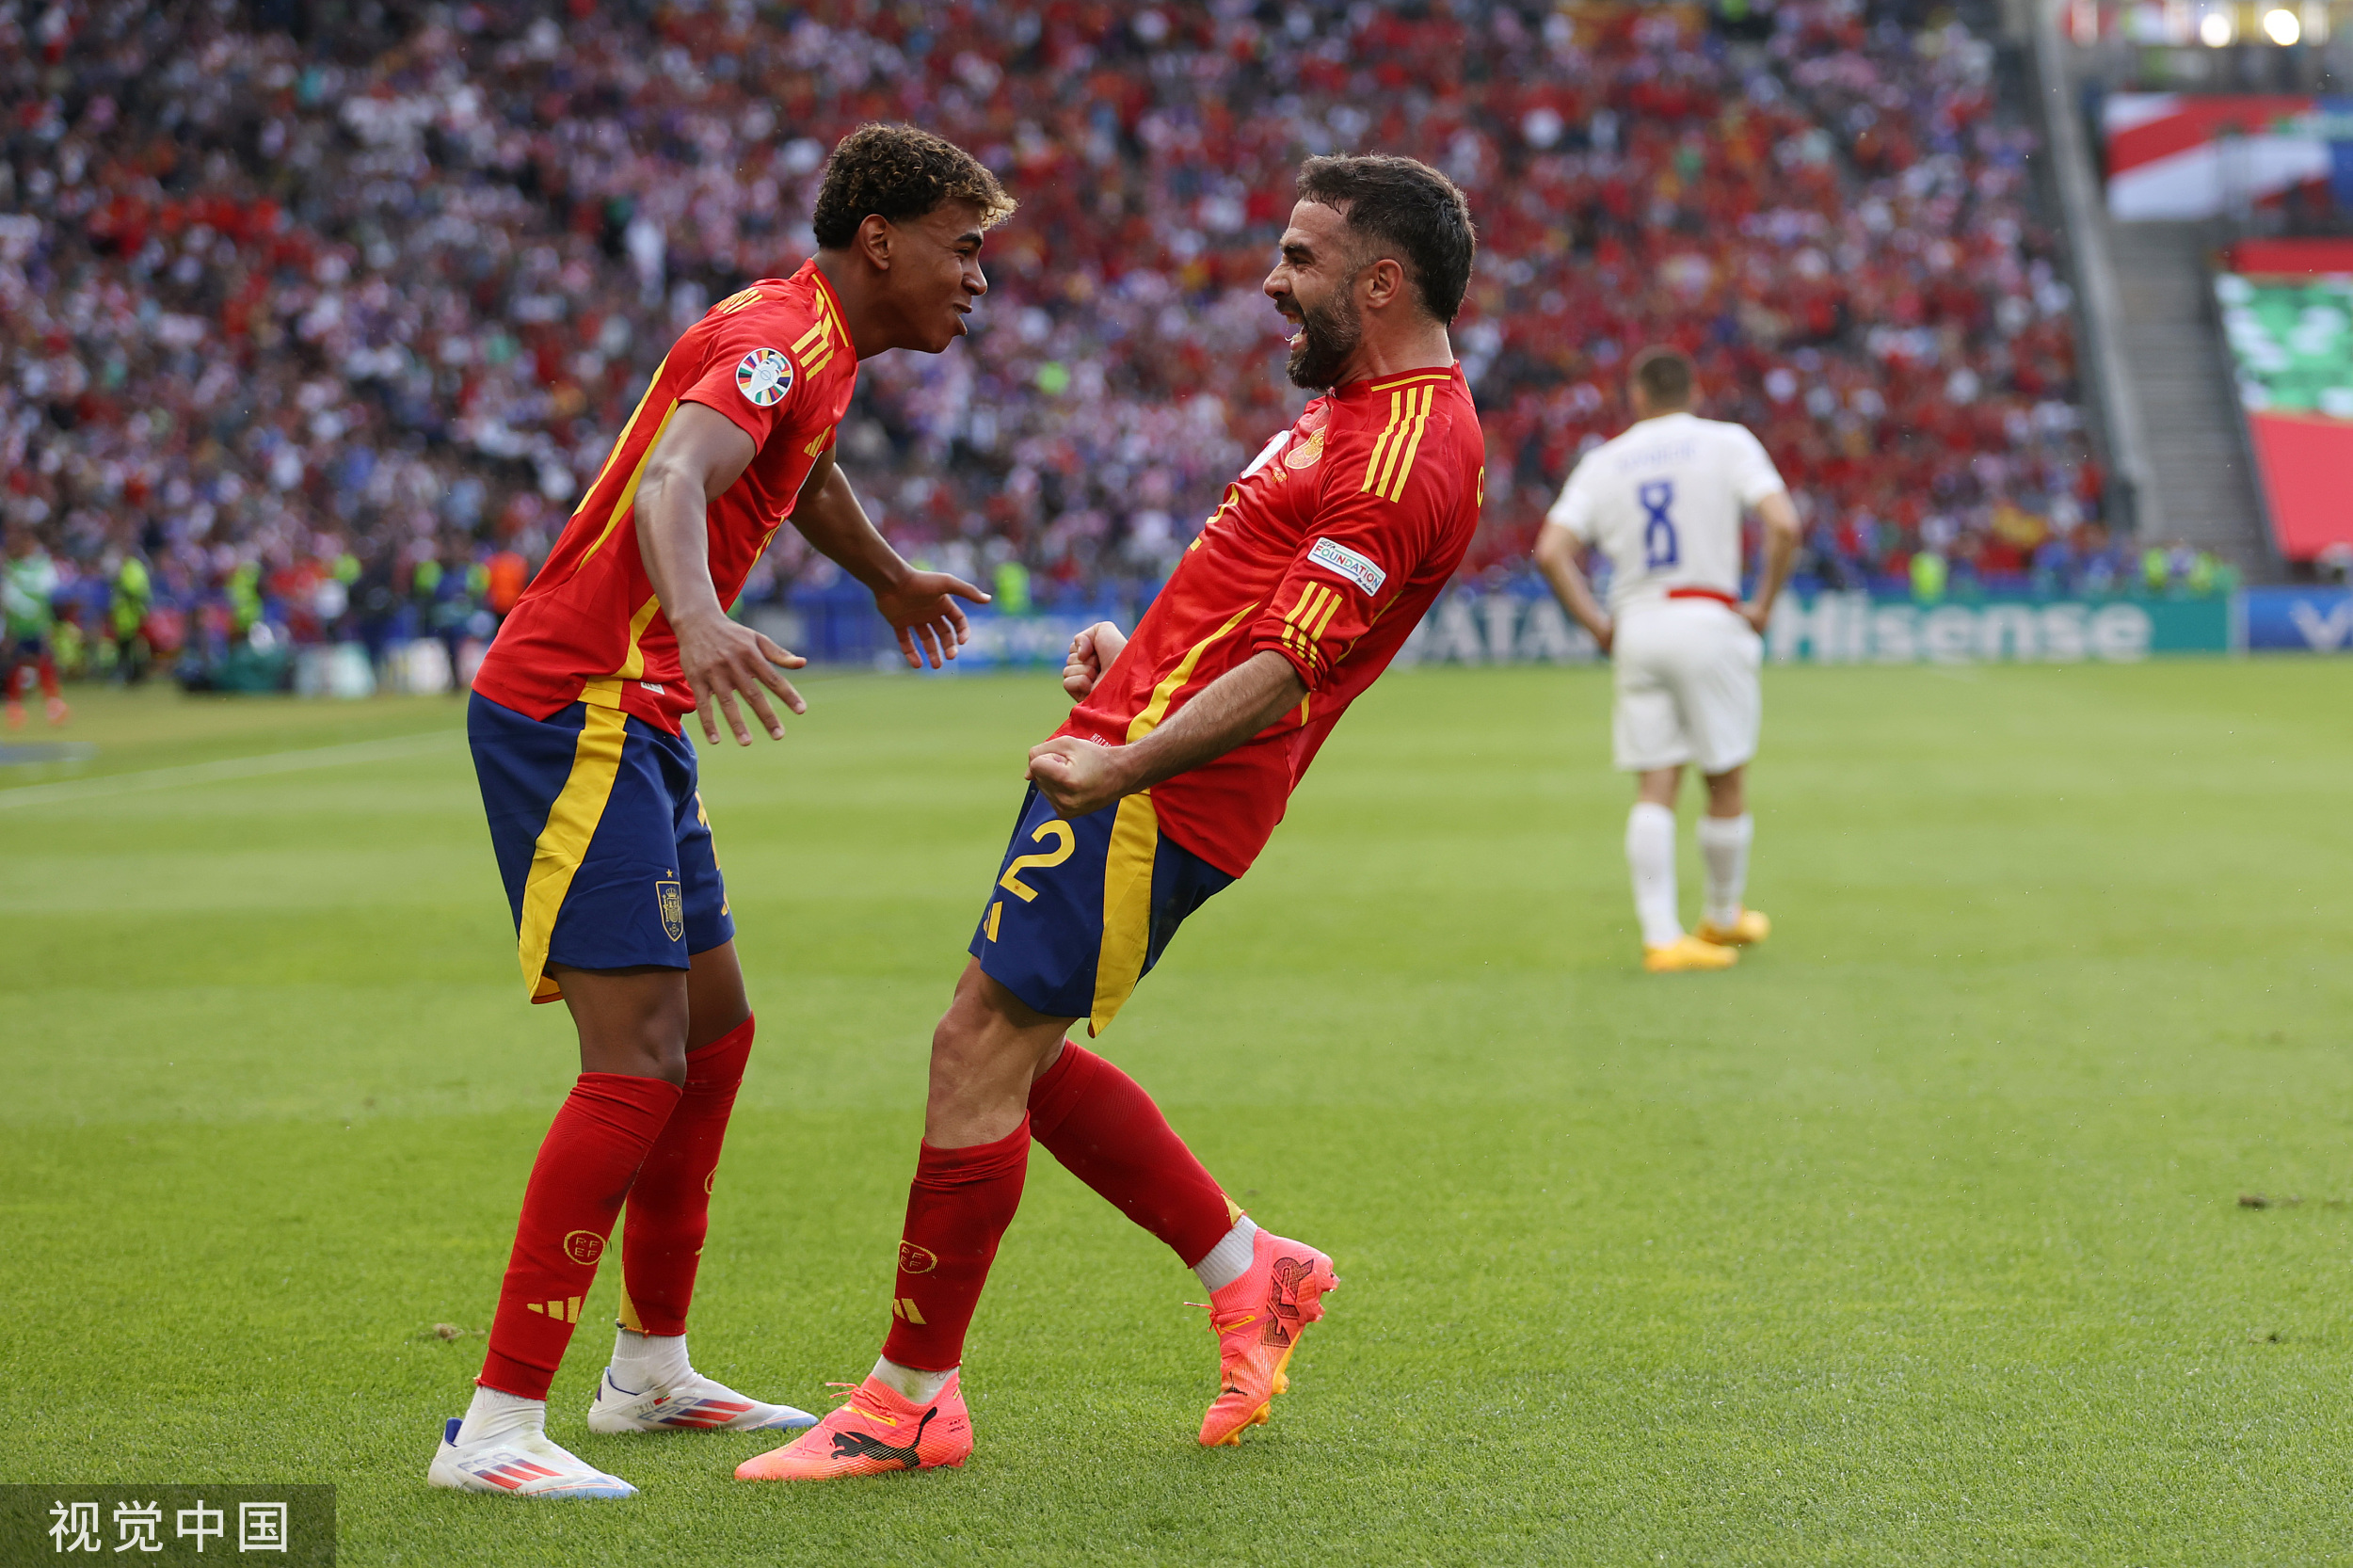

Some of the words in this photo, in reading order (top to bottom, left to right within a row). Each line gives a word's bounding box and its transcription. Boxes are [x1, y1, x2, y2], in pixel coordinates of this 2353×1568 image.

[1640, 481, 1679, 568] 8
[1314, 545, 1381, 588] FOUNDATION
[1767, 592, 2154, 664] Hisense
[999, 820, 1076, 903] 2
